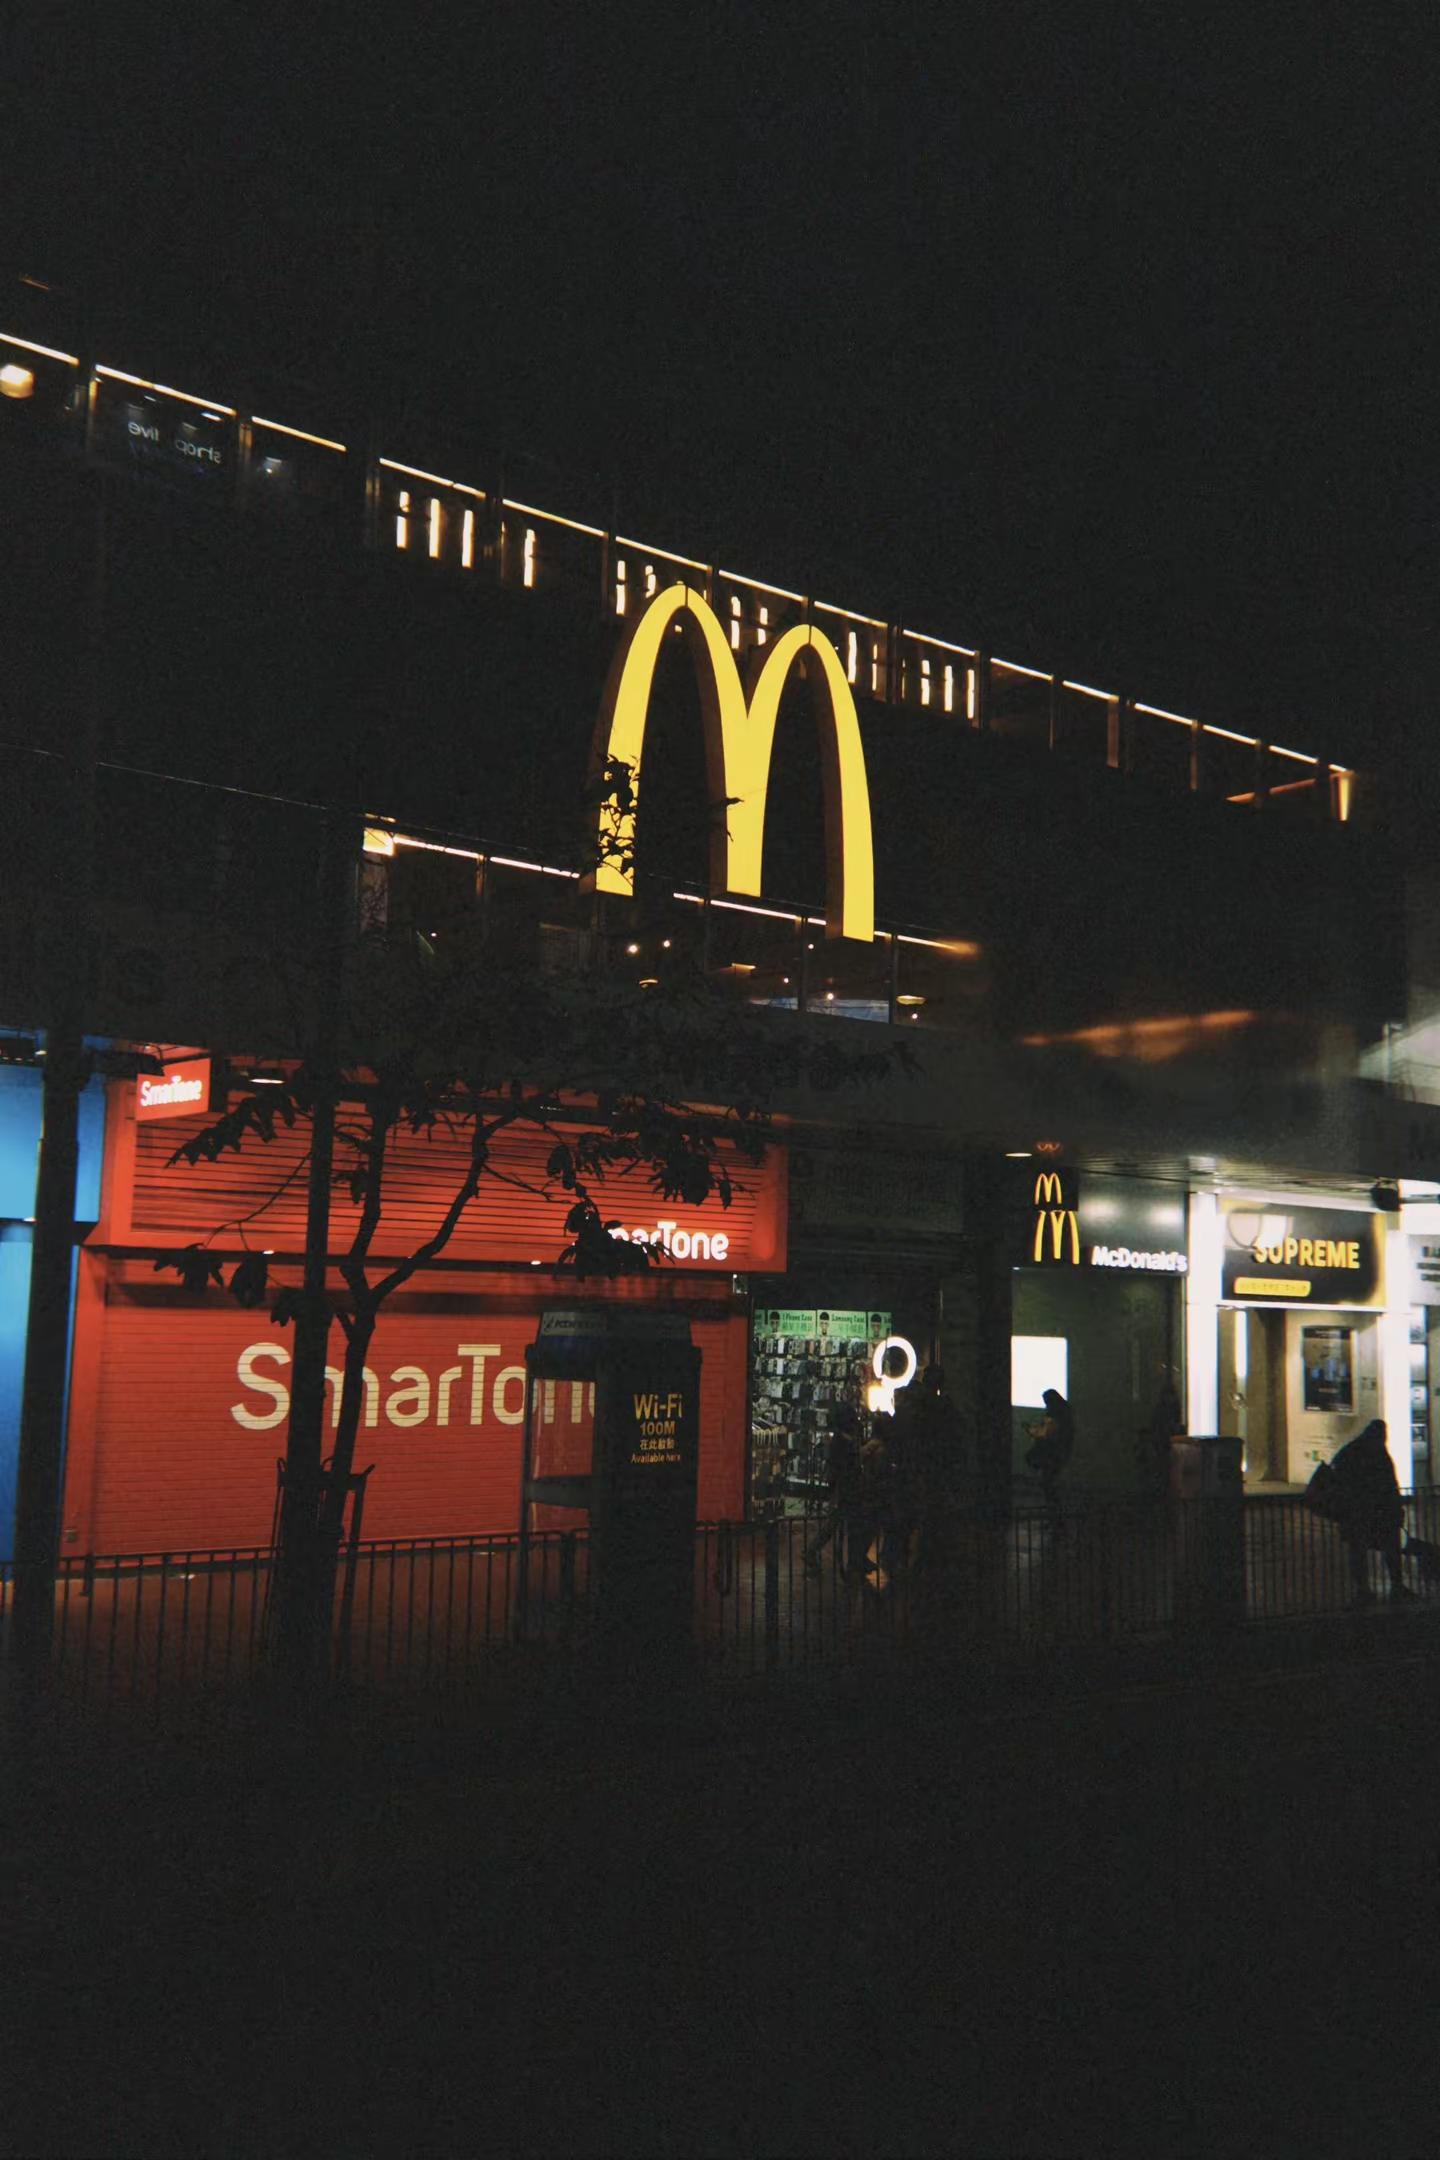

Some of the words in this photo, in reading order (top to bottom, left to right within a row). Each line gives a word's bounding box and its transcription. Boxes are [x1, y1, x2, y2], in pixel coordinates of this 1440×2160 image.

[1091, 1245, 1188, 1272] McDonald's
[230, 1342, 596, 1431] SmarTon
[633, 1393, 683, 1420] Wi-Fi
[640, 1420, 676, 1436] 100M
[631, 1452, 665, 1463] Available
